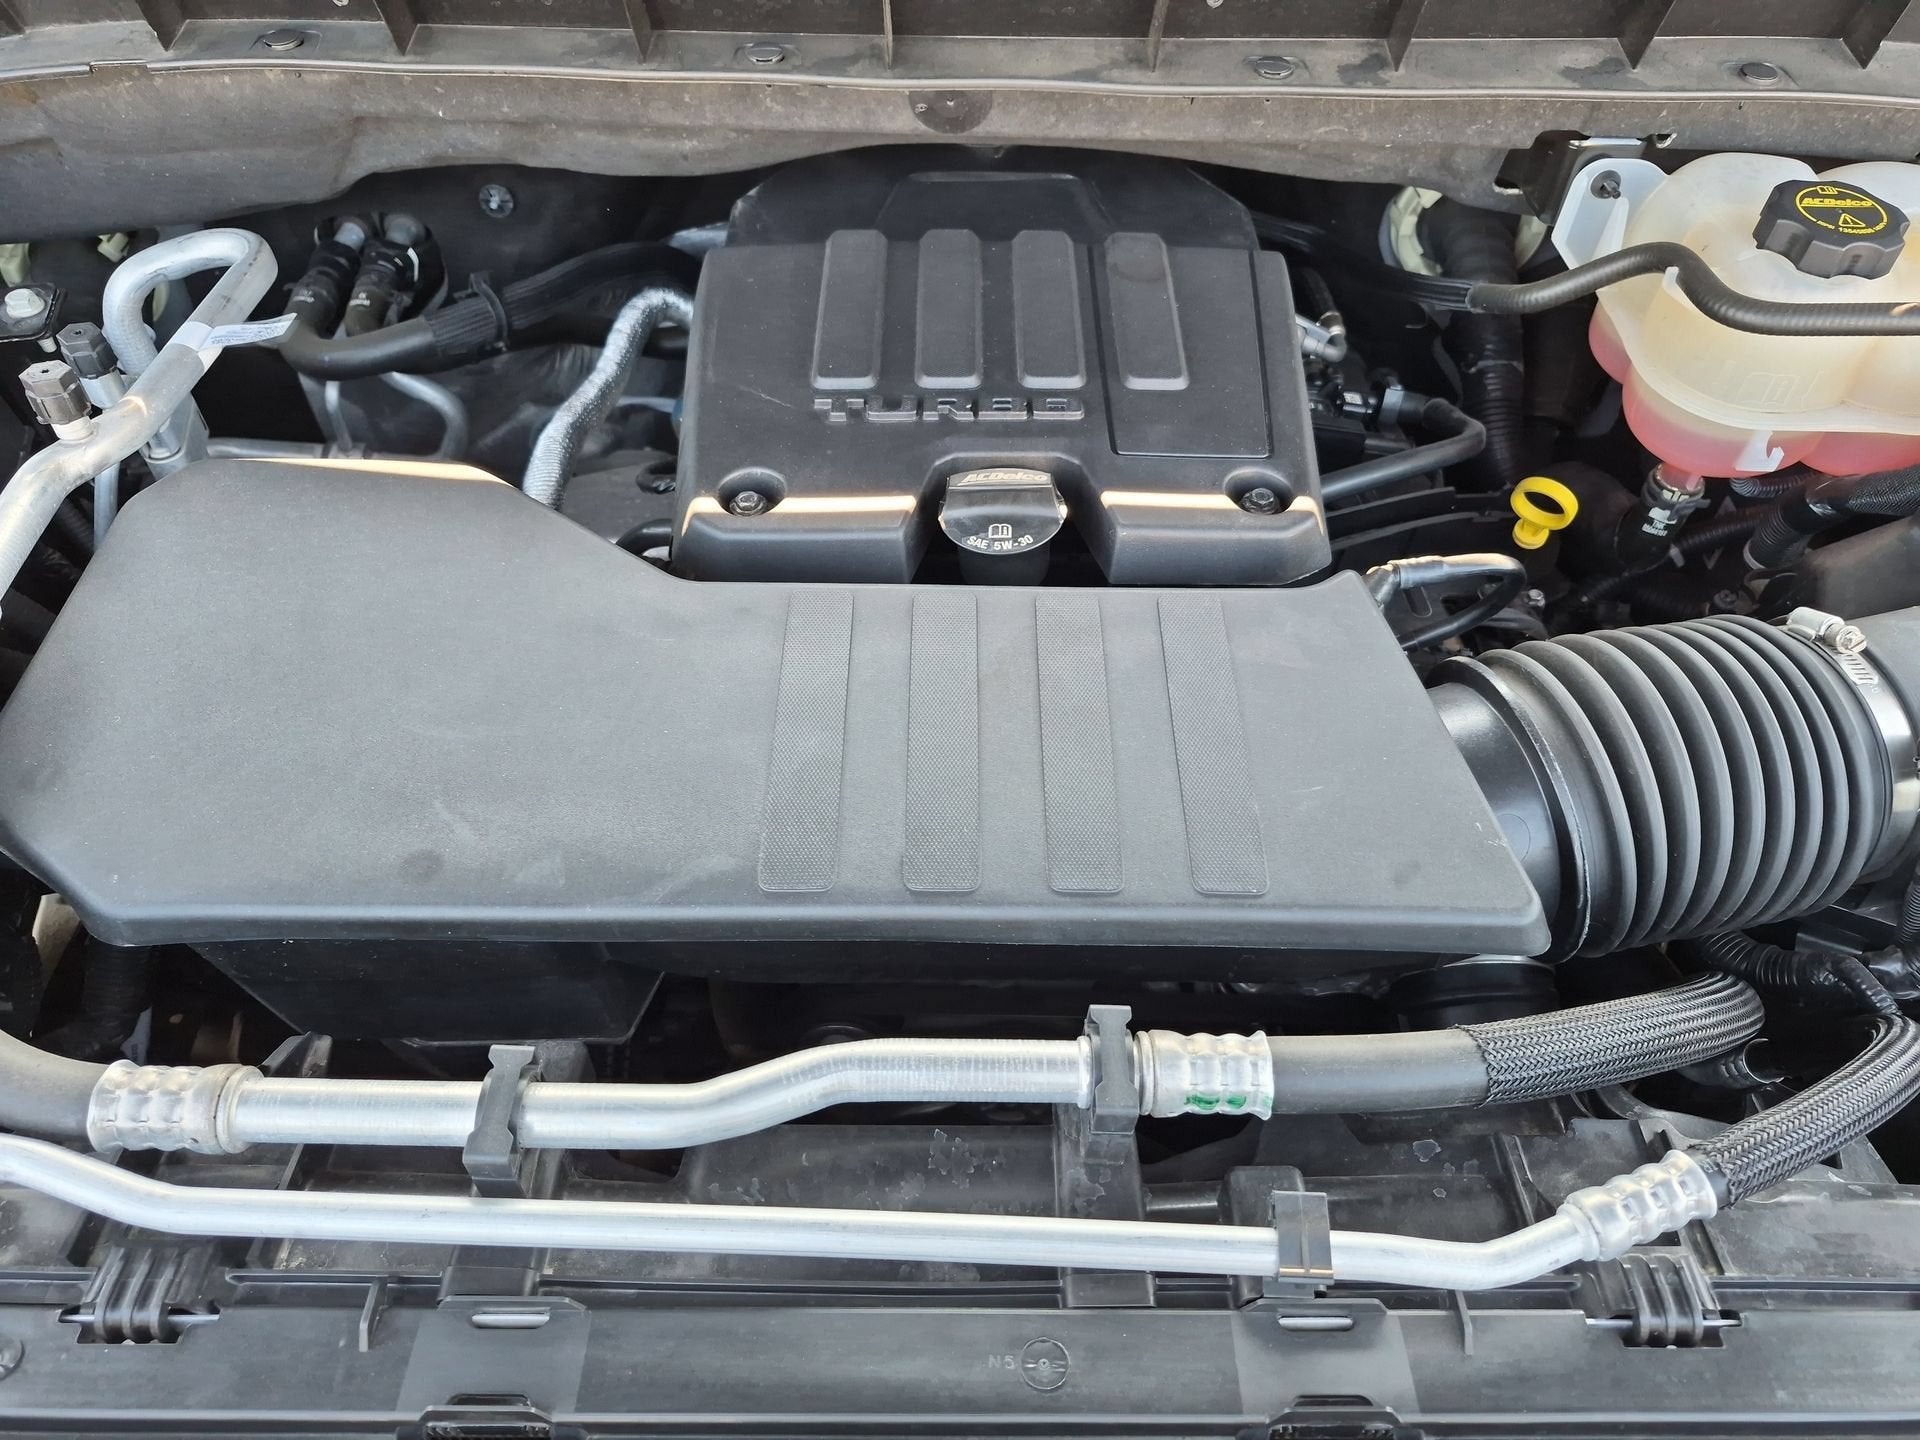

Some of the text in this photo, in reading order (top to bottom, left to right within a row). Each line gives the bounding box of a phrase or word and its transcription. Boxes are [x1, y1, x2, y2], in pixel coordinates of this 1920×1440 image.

[1801, 197, 1873, 207] ACDelco
[813, 394, 1085, 421] TURBO
[960, 471, 1048, 483] ACDelco
[966, 534, 1034, 550] SAE 5W-30
